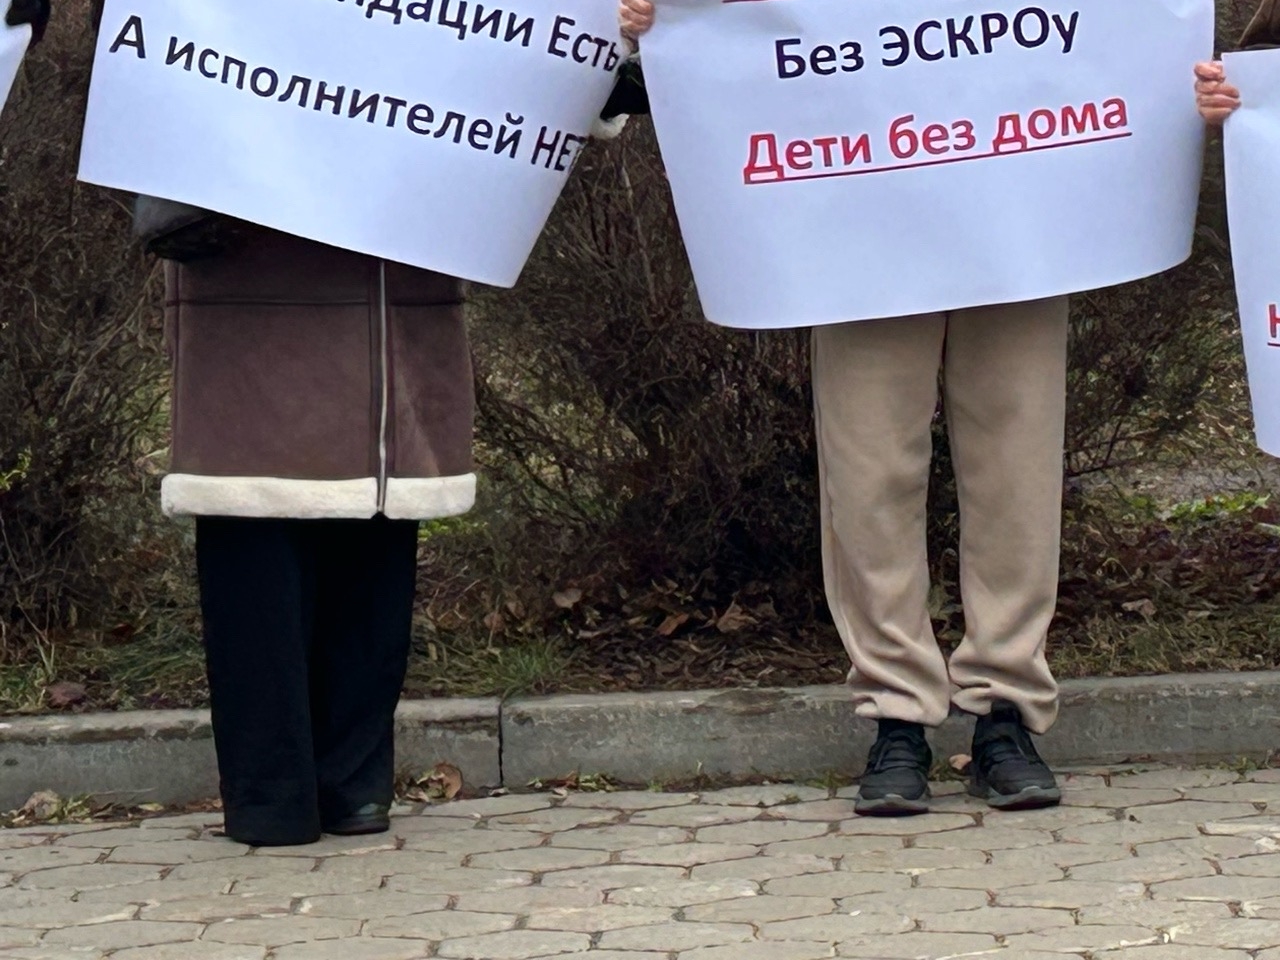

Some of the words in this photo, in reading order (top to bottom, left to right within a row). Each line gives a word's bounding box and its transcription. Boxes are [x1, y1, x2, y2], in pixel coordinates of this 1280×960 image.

[547, 14, 620, 72] Есть
[775, 36, 865, 80] Без
[880, 6, 1080, 67] ЭСКРОу
[108, 15, 148, 59] А
[164, 35, 524, 160] исполнителей
[744, 133, 871, 184] Дети
[888, 114, 976, 160] без
[992, 96, 1129, 154] дома
